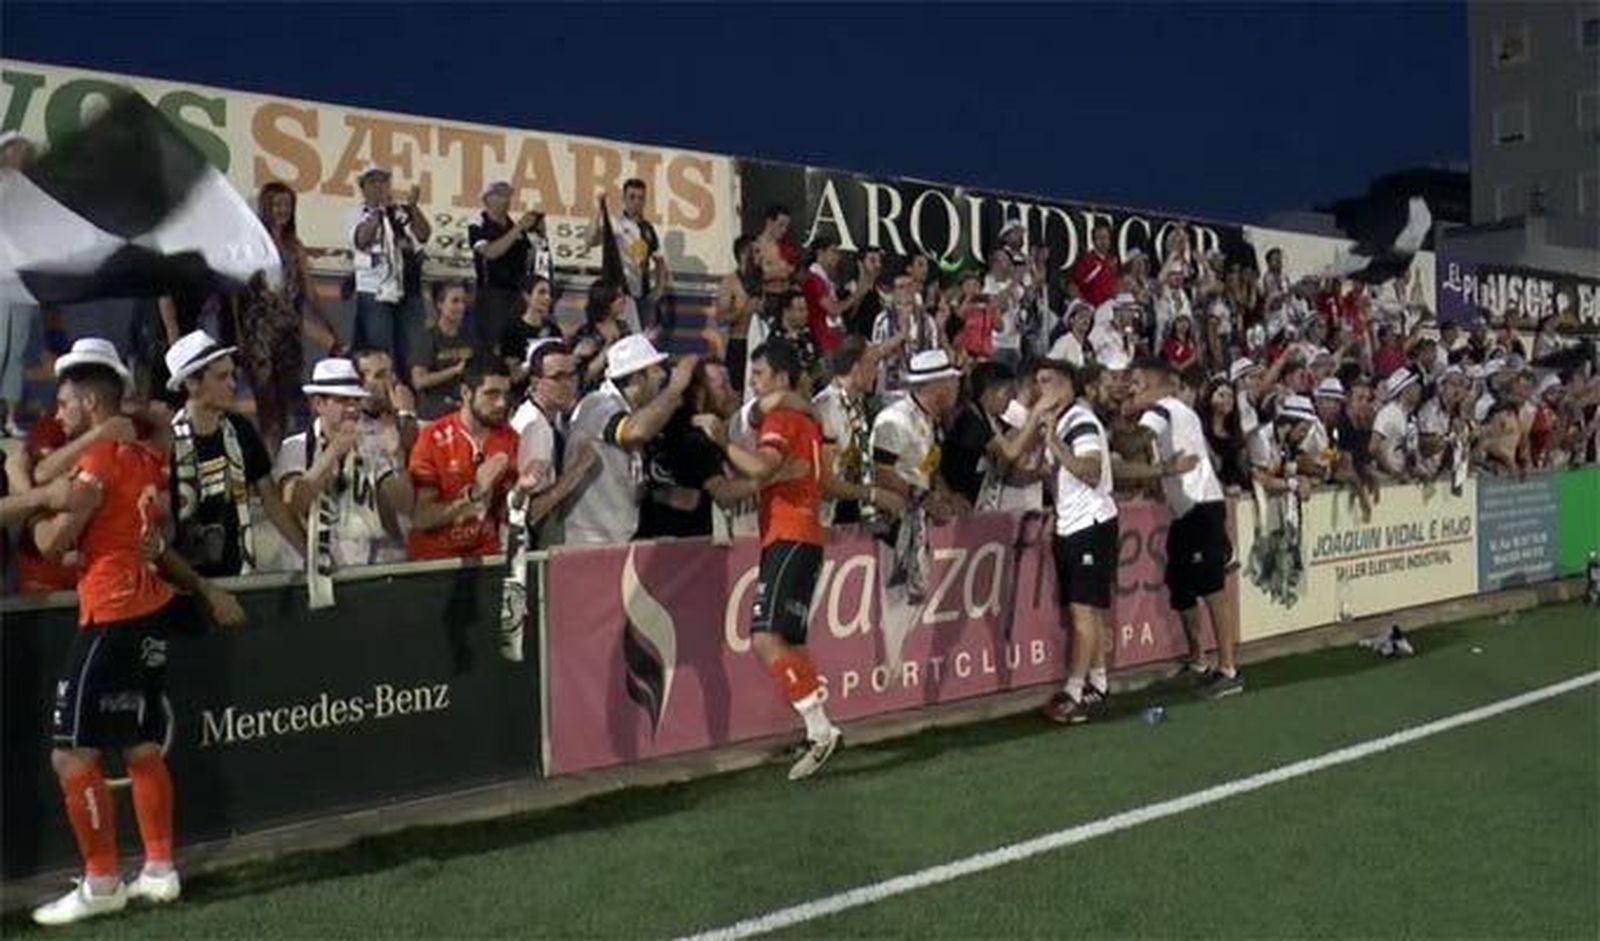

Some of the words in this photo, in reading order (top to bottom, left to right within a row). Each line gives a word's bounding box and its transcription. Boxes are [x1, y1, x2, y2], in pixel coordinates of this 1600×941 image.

[1312, 528, 1382, 558] JOAQUIN
[1385, 521, 1425, 546] VIDAL
[1441, 515, 1472, 538] HIJO
[201, 683, 451, 747] Mercedes-Benz
